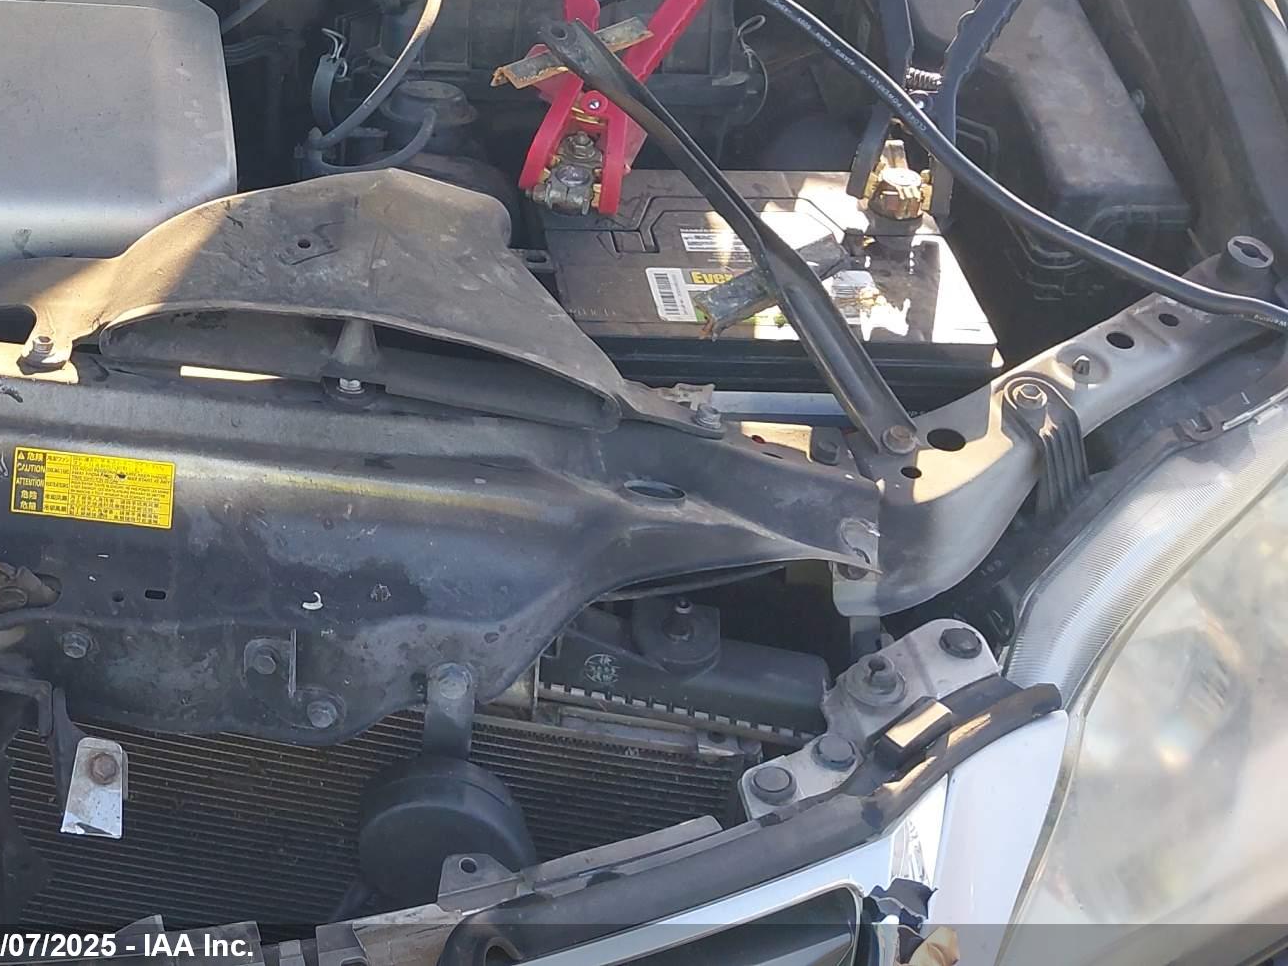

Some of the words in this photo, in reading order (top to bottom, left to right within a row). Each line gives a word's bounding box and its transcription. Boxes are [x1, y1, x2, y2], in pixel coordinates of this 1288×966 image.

[691, 271, 733, 284] Ever
[17, 462, 46, 473] CAUTION
[15, 477, 45, 488] ATTENTION
